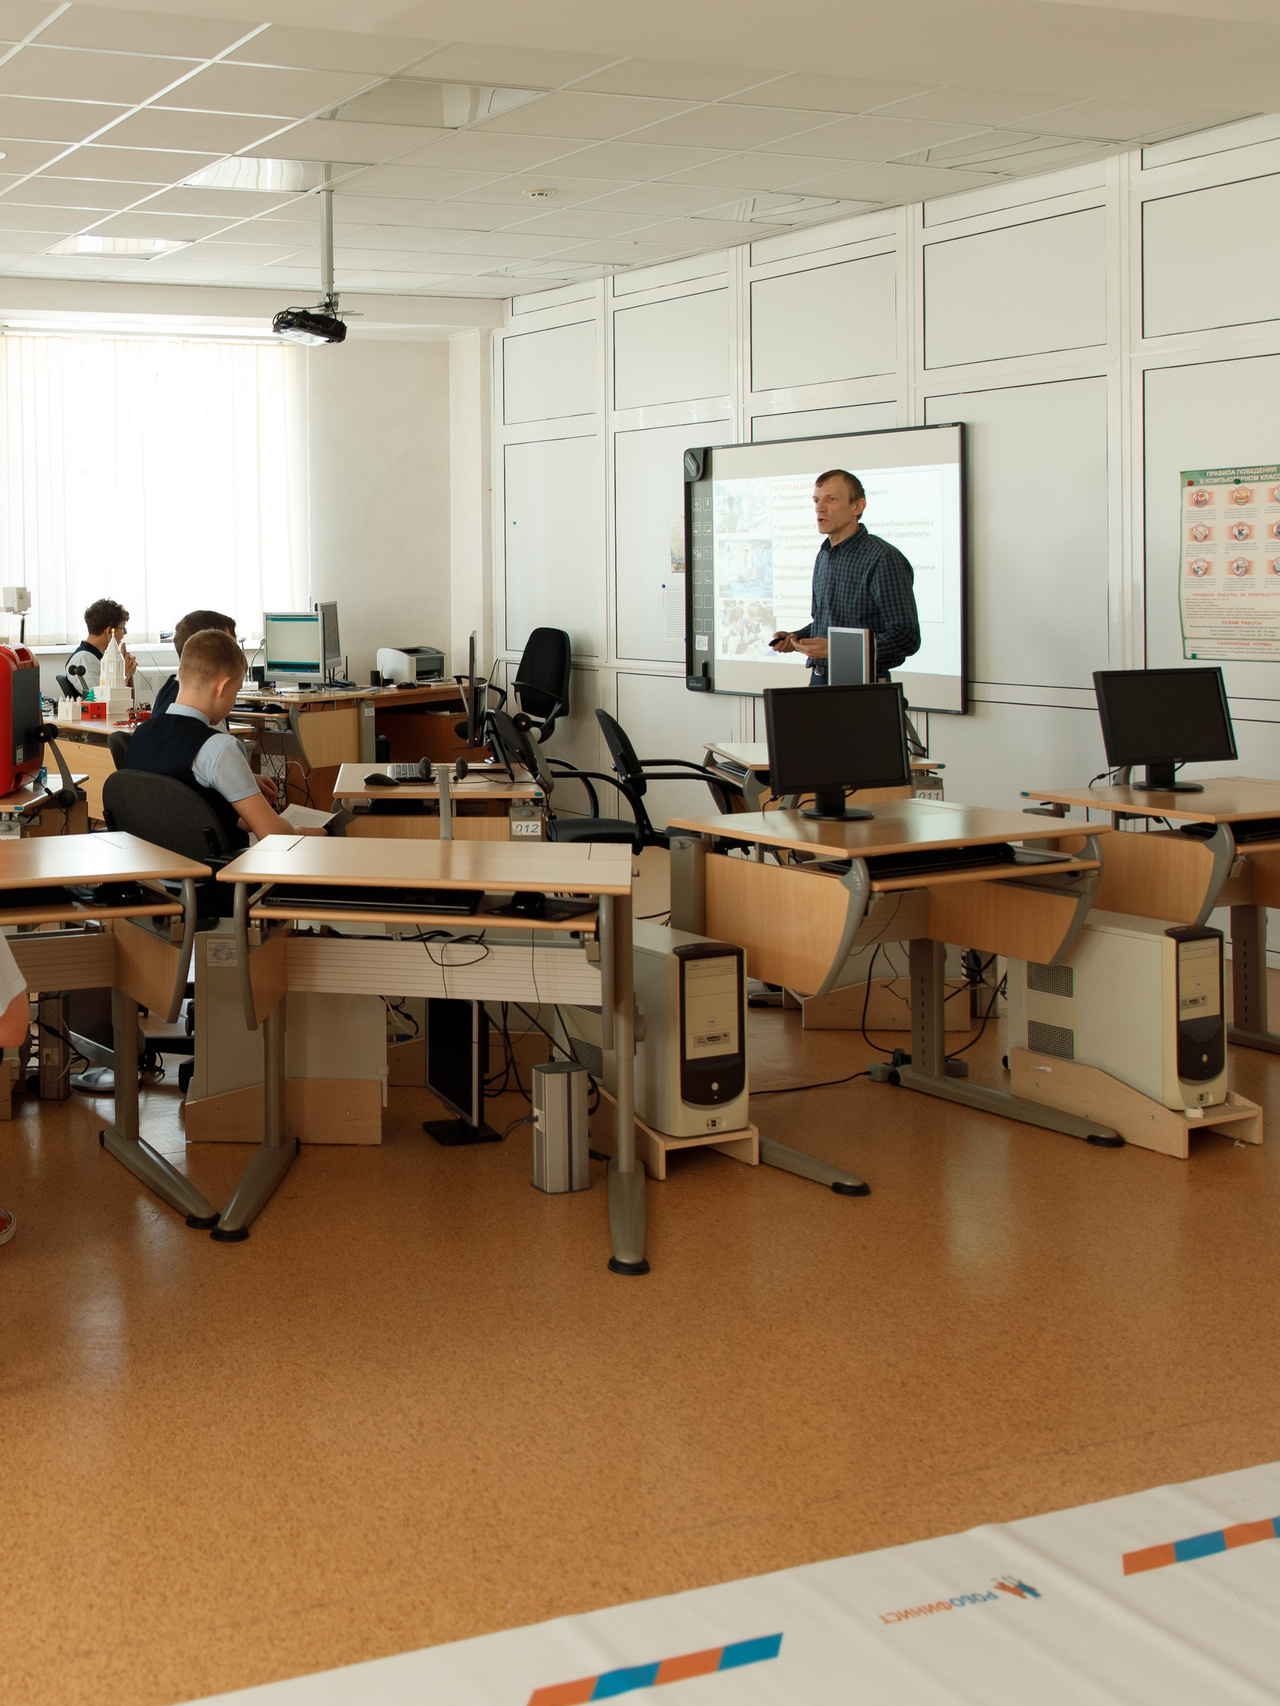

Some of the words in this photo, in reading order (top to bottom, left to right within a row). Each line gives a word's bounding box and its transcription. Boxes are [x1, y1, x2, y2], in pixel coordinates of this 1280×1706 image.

[1206, 469, 1236, 477] ПРАВИЛА
[1237, 466, 1277, 475] ПОВЕДЕНИЯ
[1260, 472, 1280, 480] КЛАСС
[515, 823, 539, 833] 012
[879, 1590, 1000, 1624] РОБОФИНИСТ
